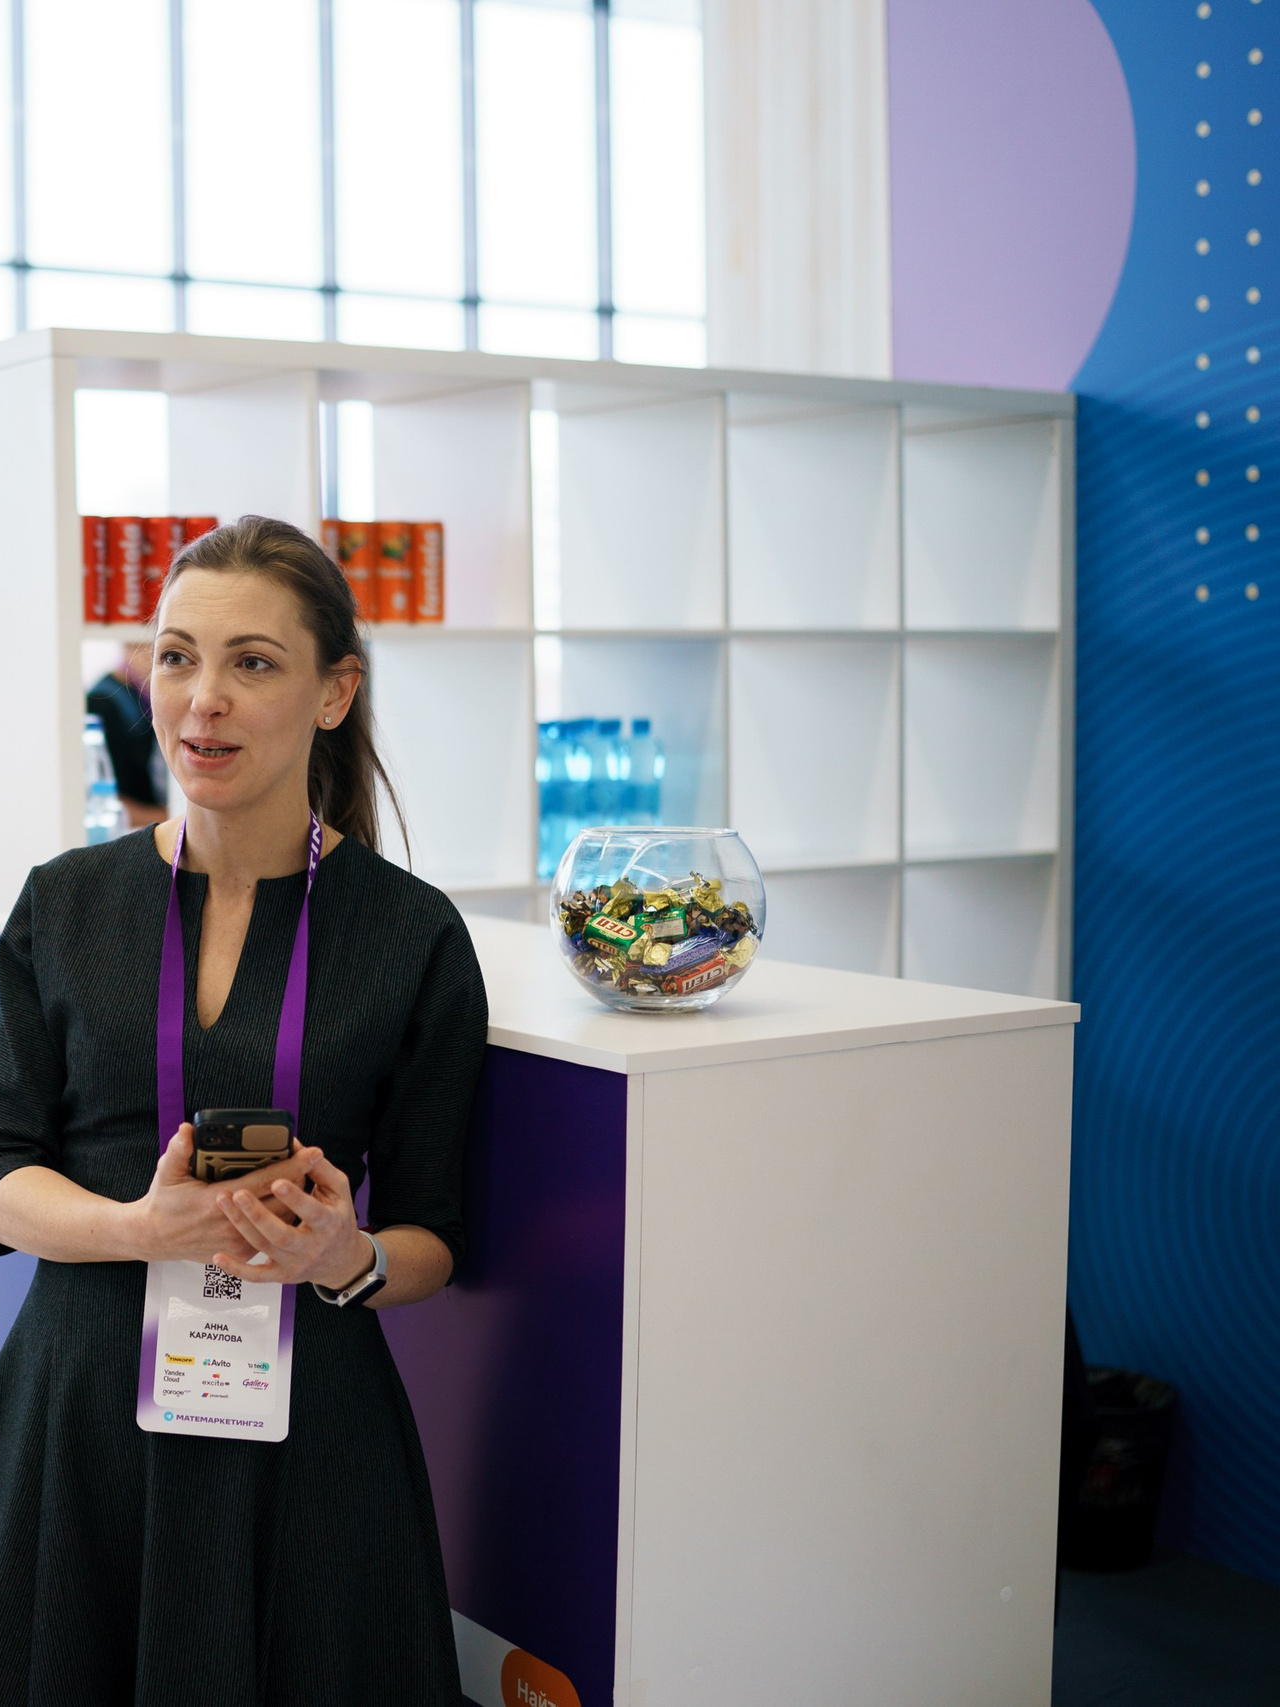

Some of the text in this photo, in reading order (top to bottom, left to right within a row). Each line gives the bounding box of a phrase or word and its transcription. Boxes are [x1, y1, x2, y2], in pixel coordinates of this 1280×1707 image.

[596, 918, 634, 937] СТЕП
[204, 1323, 229, 1332] АННА
[189, 1331, 243, 1343] КАРАУЛОВА
[211, 1359, 231, 1368] Avito
[176, 1414, 264, 1428] МАТЕМАРКЕТИНГ22
